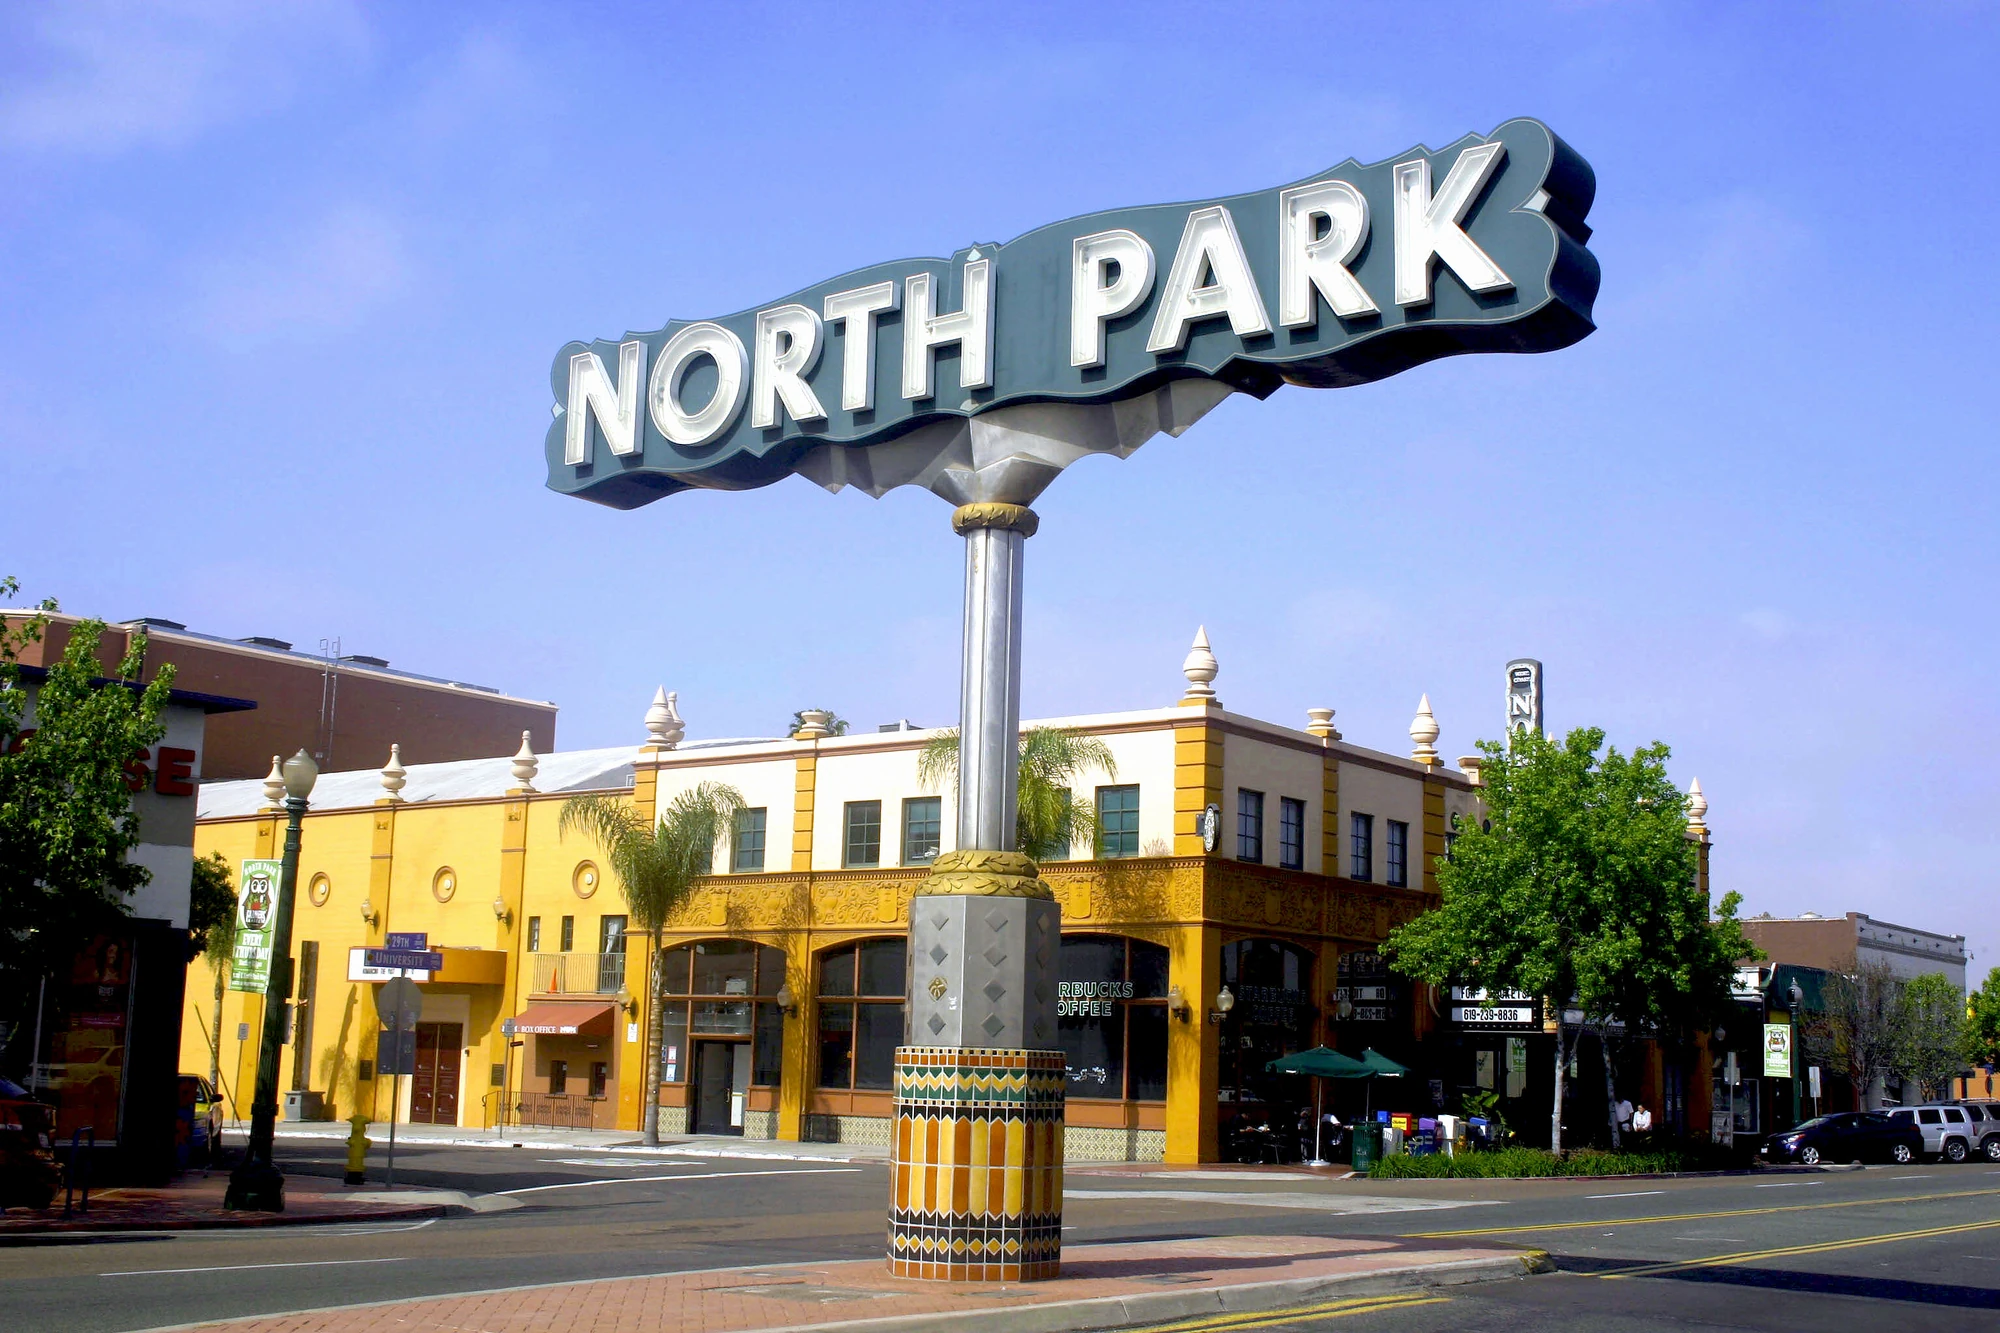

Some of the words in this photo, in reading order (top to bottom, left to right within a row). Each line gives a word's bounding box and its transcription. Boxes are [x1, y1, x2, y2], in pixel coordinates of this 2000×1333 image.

[564, 258, 997, 466] NORTH
[1069, 141, 1516, 370] PARK
[263, 862, 277, 876] PARK
[391, 935, 410, 948] 29TH
[1463, 1009, 1518, 1021] 619-239-8836
[521, 1025, 534, 1033] BOX
[534, 1025, 557, 1034] OFFICE
